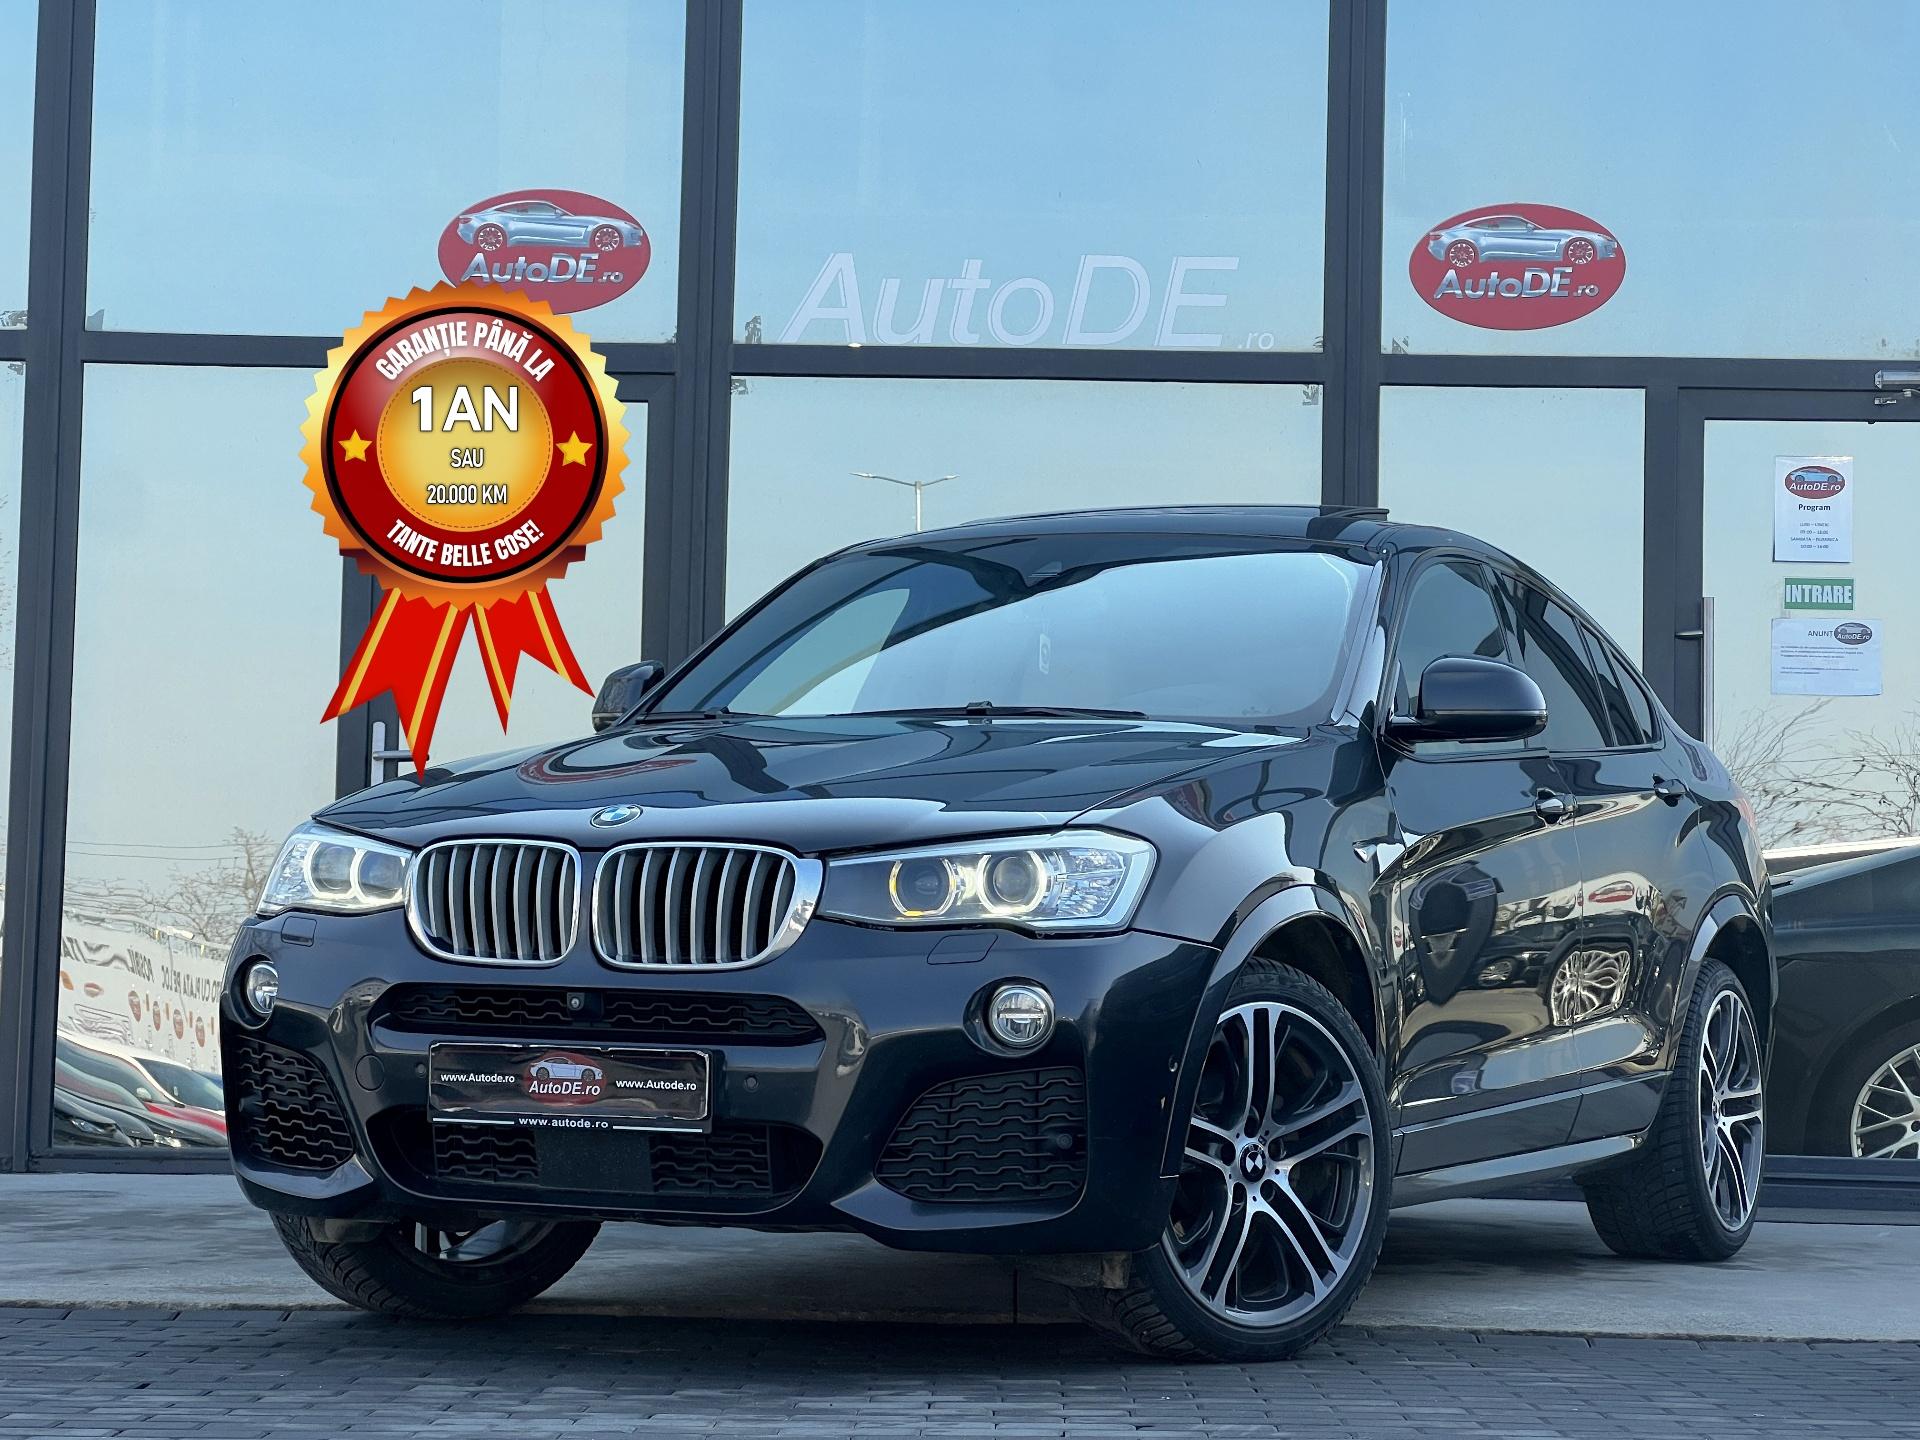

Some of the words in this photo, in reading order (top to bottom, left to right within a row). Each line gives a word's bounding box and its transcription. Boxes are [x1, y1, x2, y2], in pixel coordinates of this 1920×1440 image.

[1789, 482, 1841, 491] AutoDE.ro
[1798, 503, 1831, 512] Program
[1785, 584, 1852, 604] INTRARE
[440, 1073, 516, 1084] www.Autode.ro
[528, 1080, 601, 1097] AutoDE.ro
[615, 1079, 697, 1091] www.Autode.ro
[518, 1117, 609, 1129] www.autode.ro
